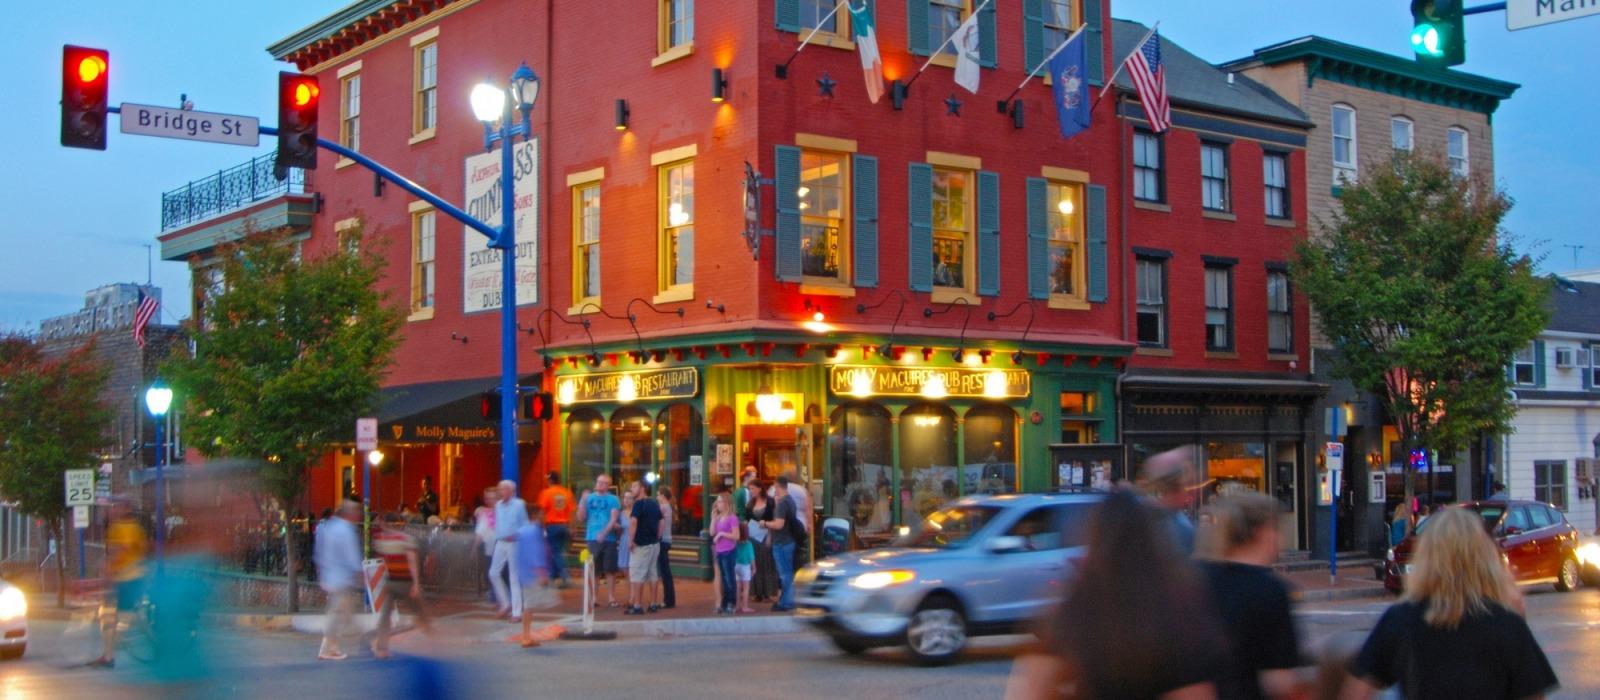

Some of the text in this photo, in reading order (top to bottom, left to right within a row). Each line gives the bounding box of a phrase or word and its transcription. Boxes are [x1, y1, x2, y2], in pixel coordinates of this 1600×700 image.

[138, 109, 242, 136] Bridge St
[470, 241, 535, 267] EXTRA OUT
[483, 292, 503, 307] DUB
[641, 369, 693, 397] RESTAURANT
[836, 366, 877, 390] MOY
[962, 371, 1025, 393] RESTANT
[416, 425, 496, 441] Molly Maguire's
[69, 488, 92, 502] 25
